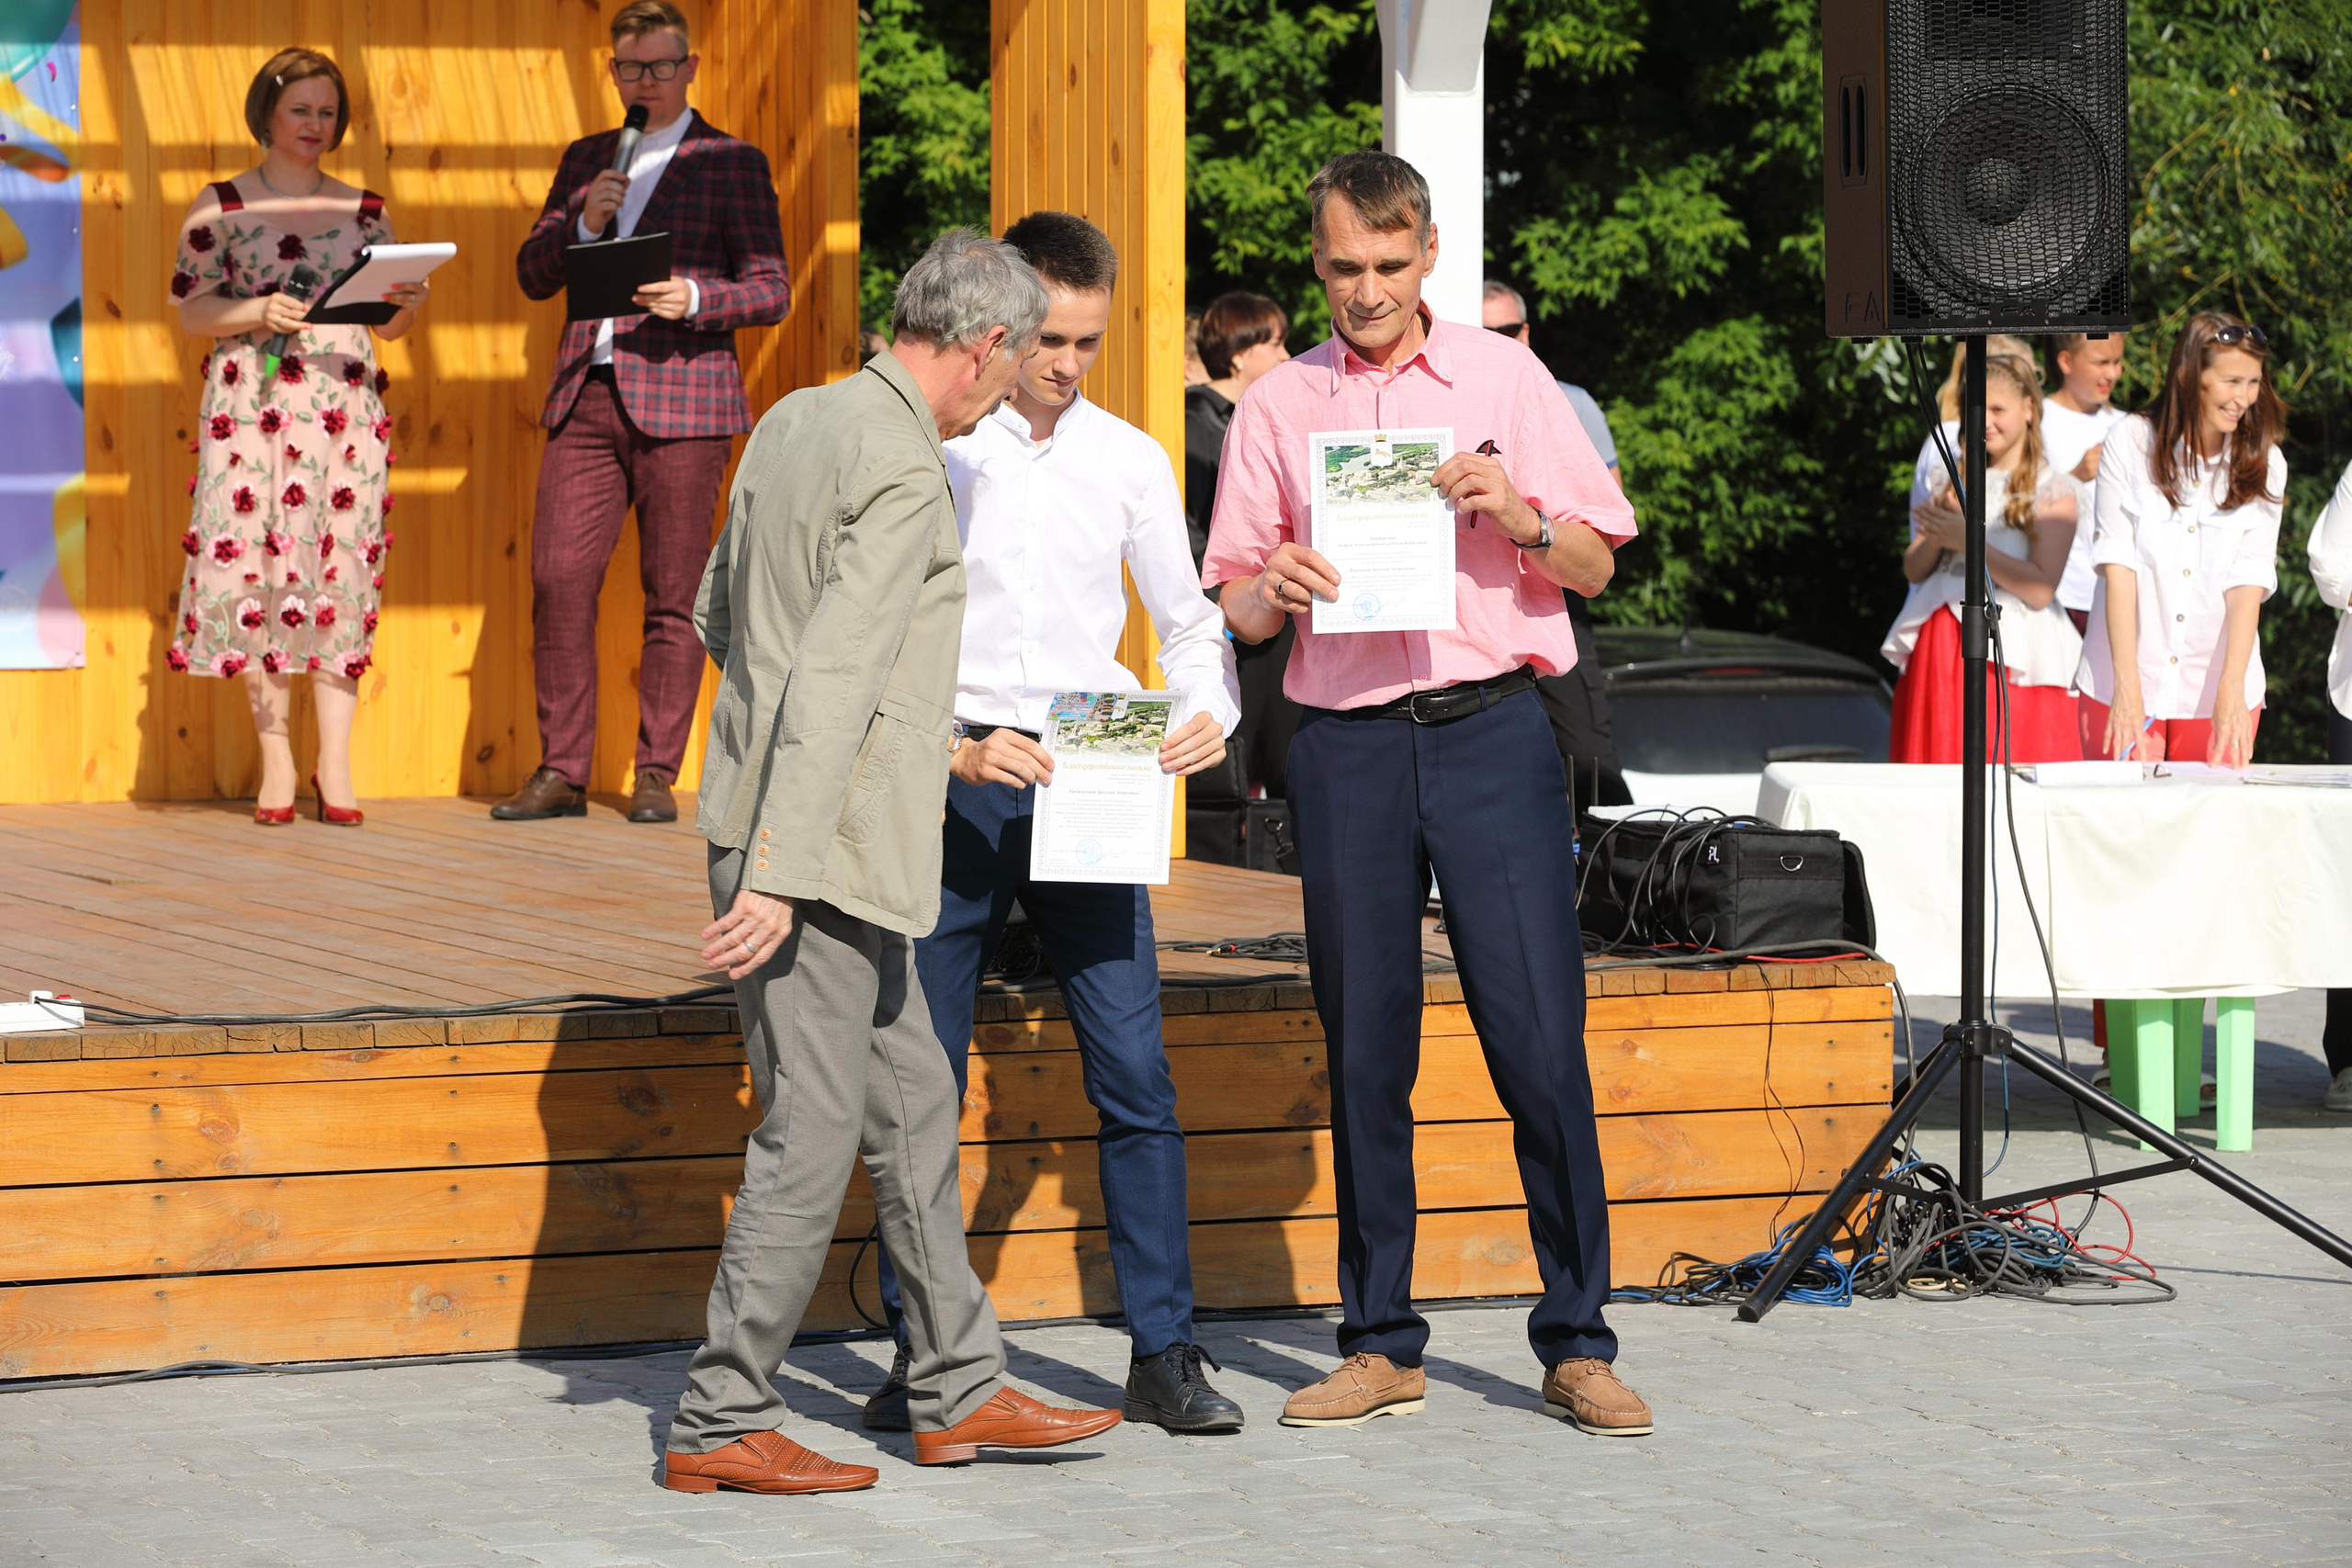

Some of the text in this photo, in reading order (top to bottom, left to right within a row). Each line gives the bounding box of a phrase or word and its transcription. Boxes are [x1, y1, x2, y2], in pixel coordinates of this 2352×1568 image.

[1845, 291, 1881, 322] FA
[1337, 512, 1430, 522] Благодарственное письмо
[1061, 761, 1126, 772] Благодарственное
